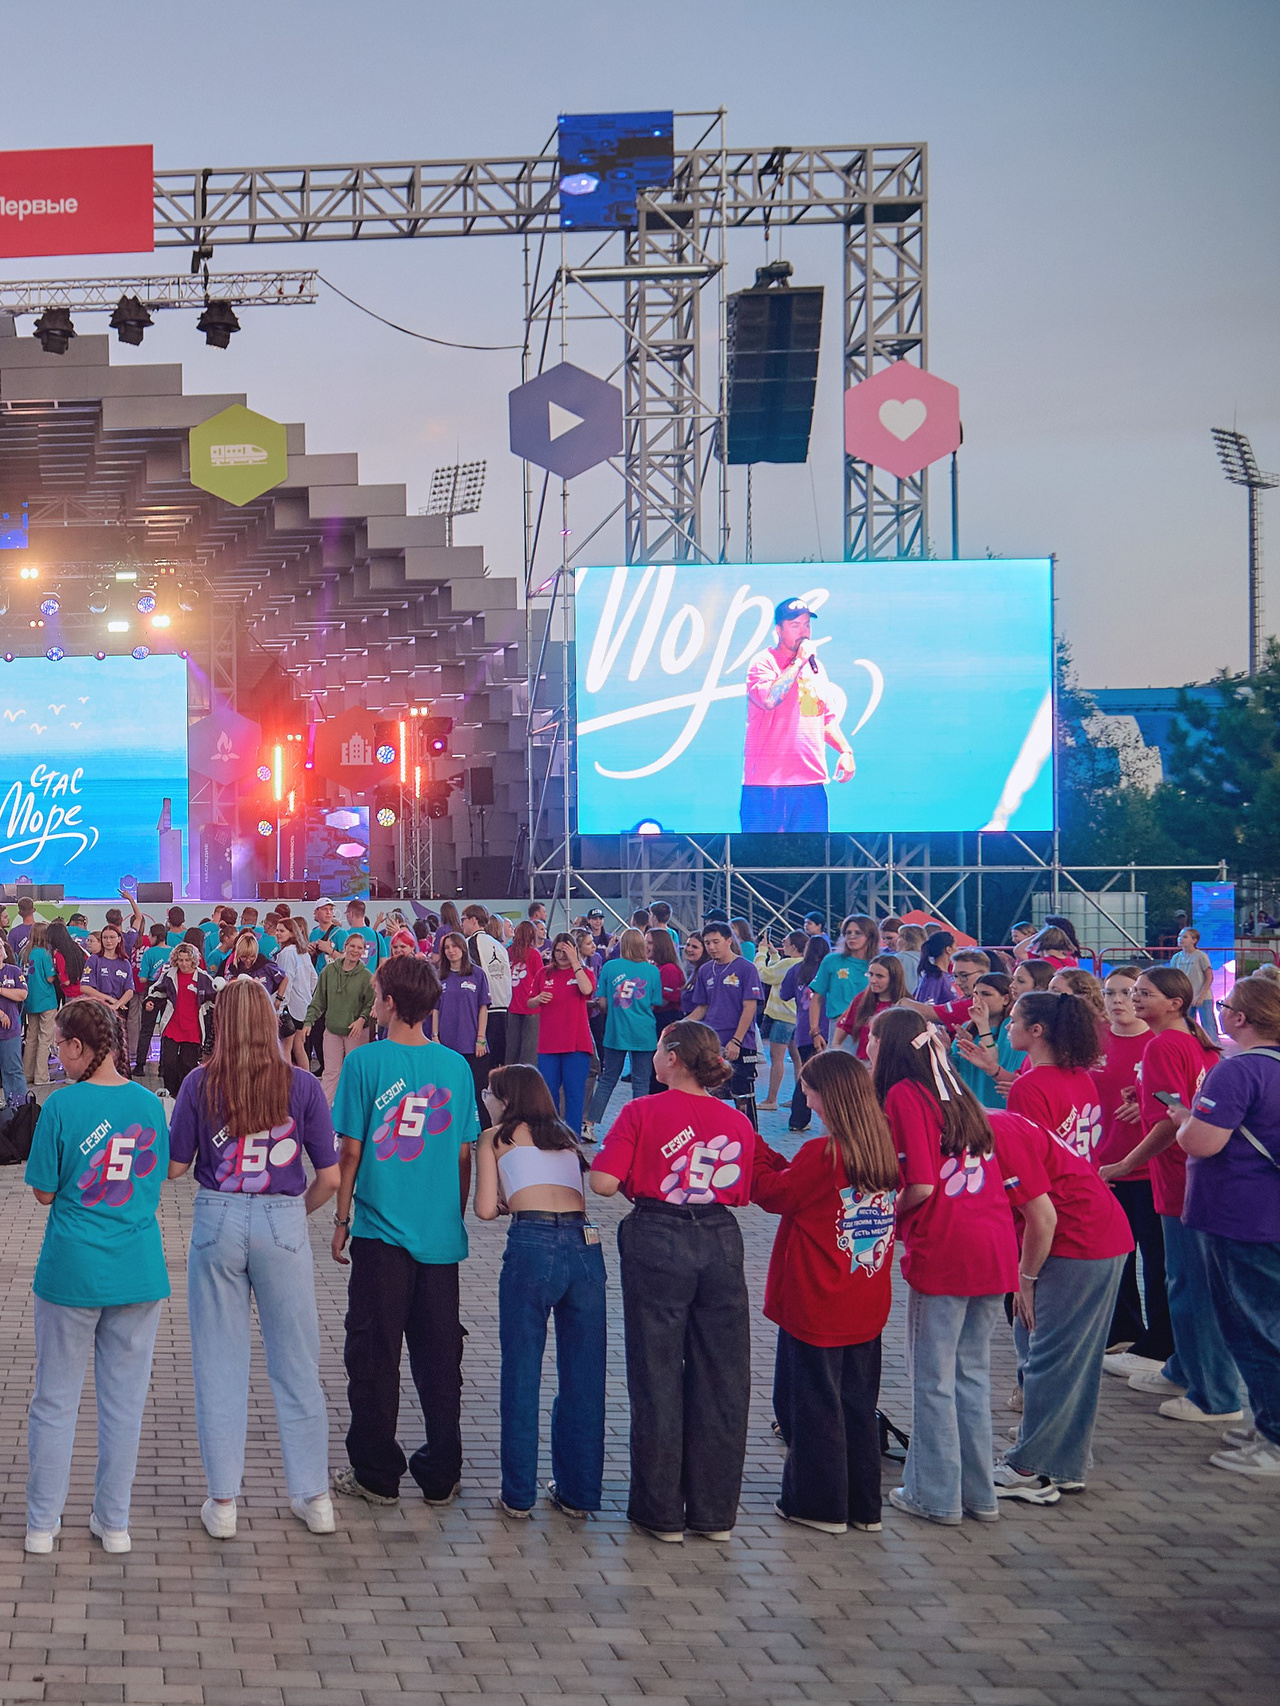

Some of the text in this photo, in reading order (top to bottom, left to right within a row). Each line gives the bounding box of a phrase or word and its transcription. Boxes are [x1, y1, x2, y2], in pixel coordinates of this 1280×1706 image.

[30, 763, 84, 799] СТАС
[620, 980, 637, 998] 5
[375, 1078, 407, 1110] СЕЗОН
[398, 1096, 429, 1137] 5
[1055, 1104, 1078, 1138] СЕЗОН
[79, 1118, 112, 1155] СЕЗОН
[241, 1130, 270, 1172] 5
[660, 1125, 696, 1159] СЕЗОН
[1076, 1117, 1091, 1155] 5
[106, 1137, 136, 1181] 5
[689, 1146, 721, 1189] 5
